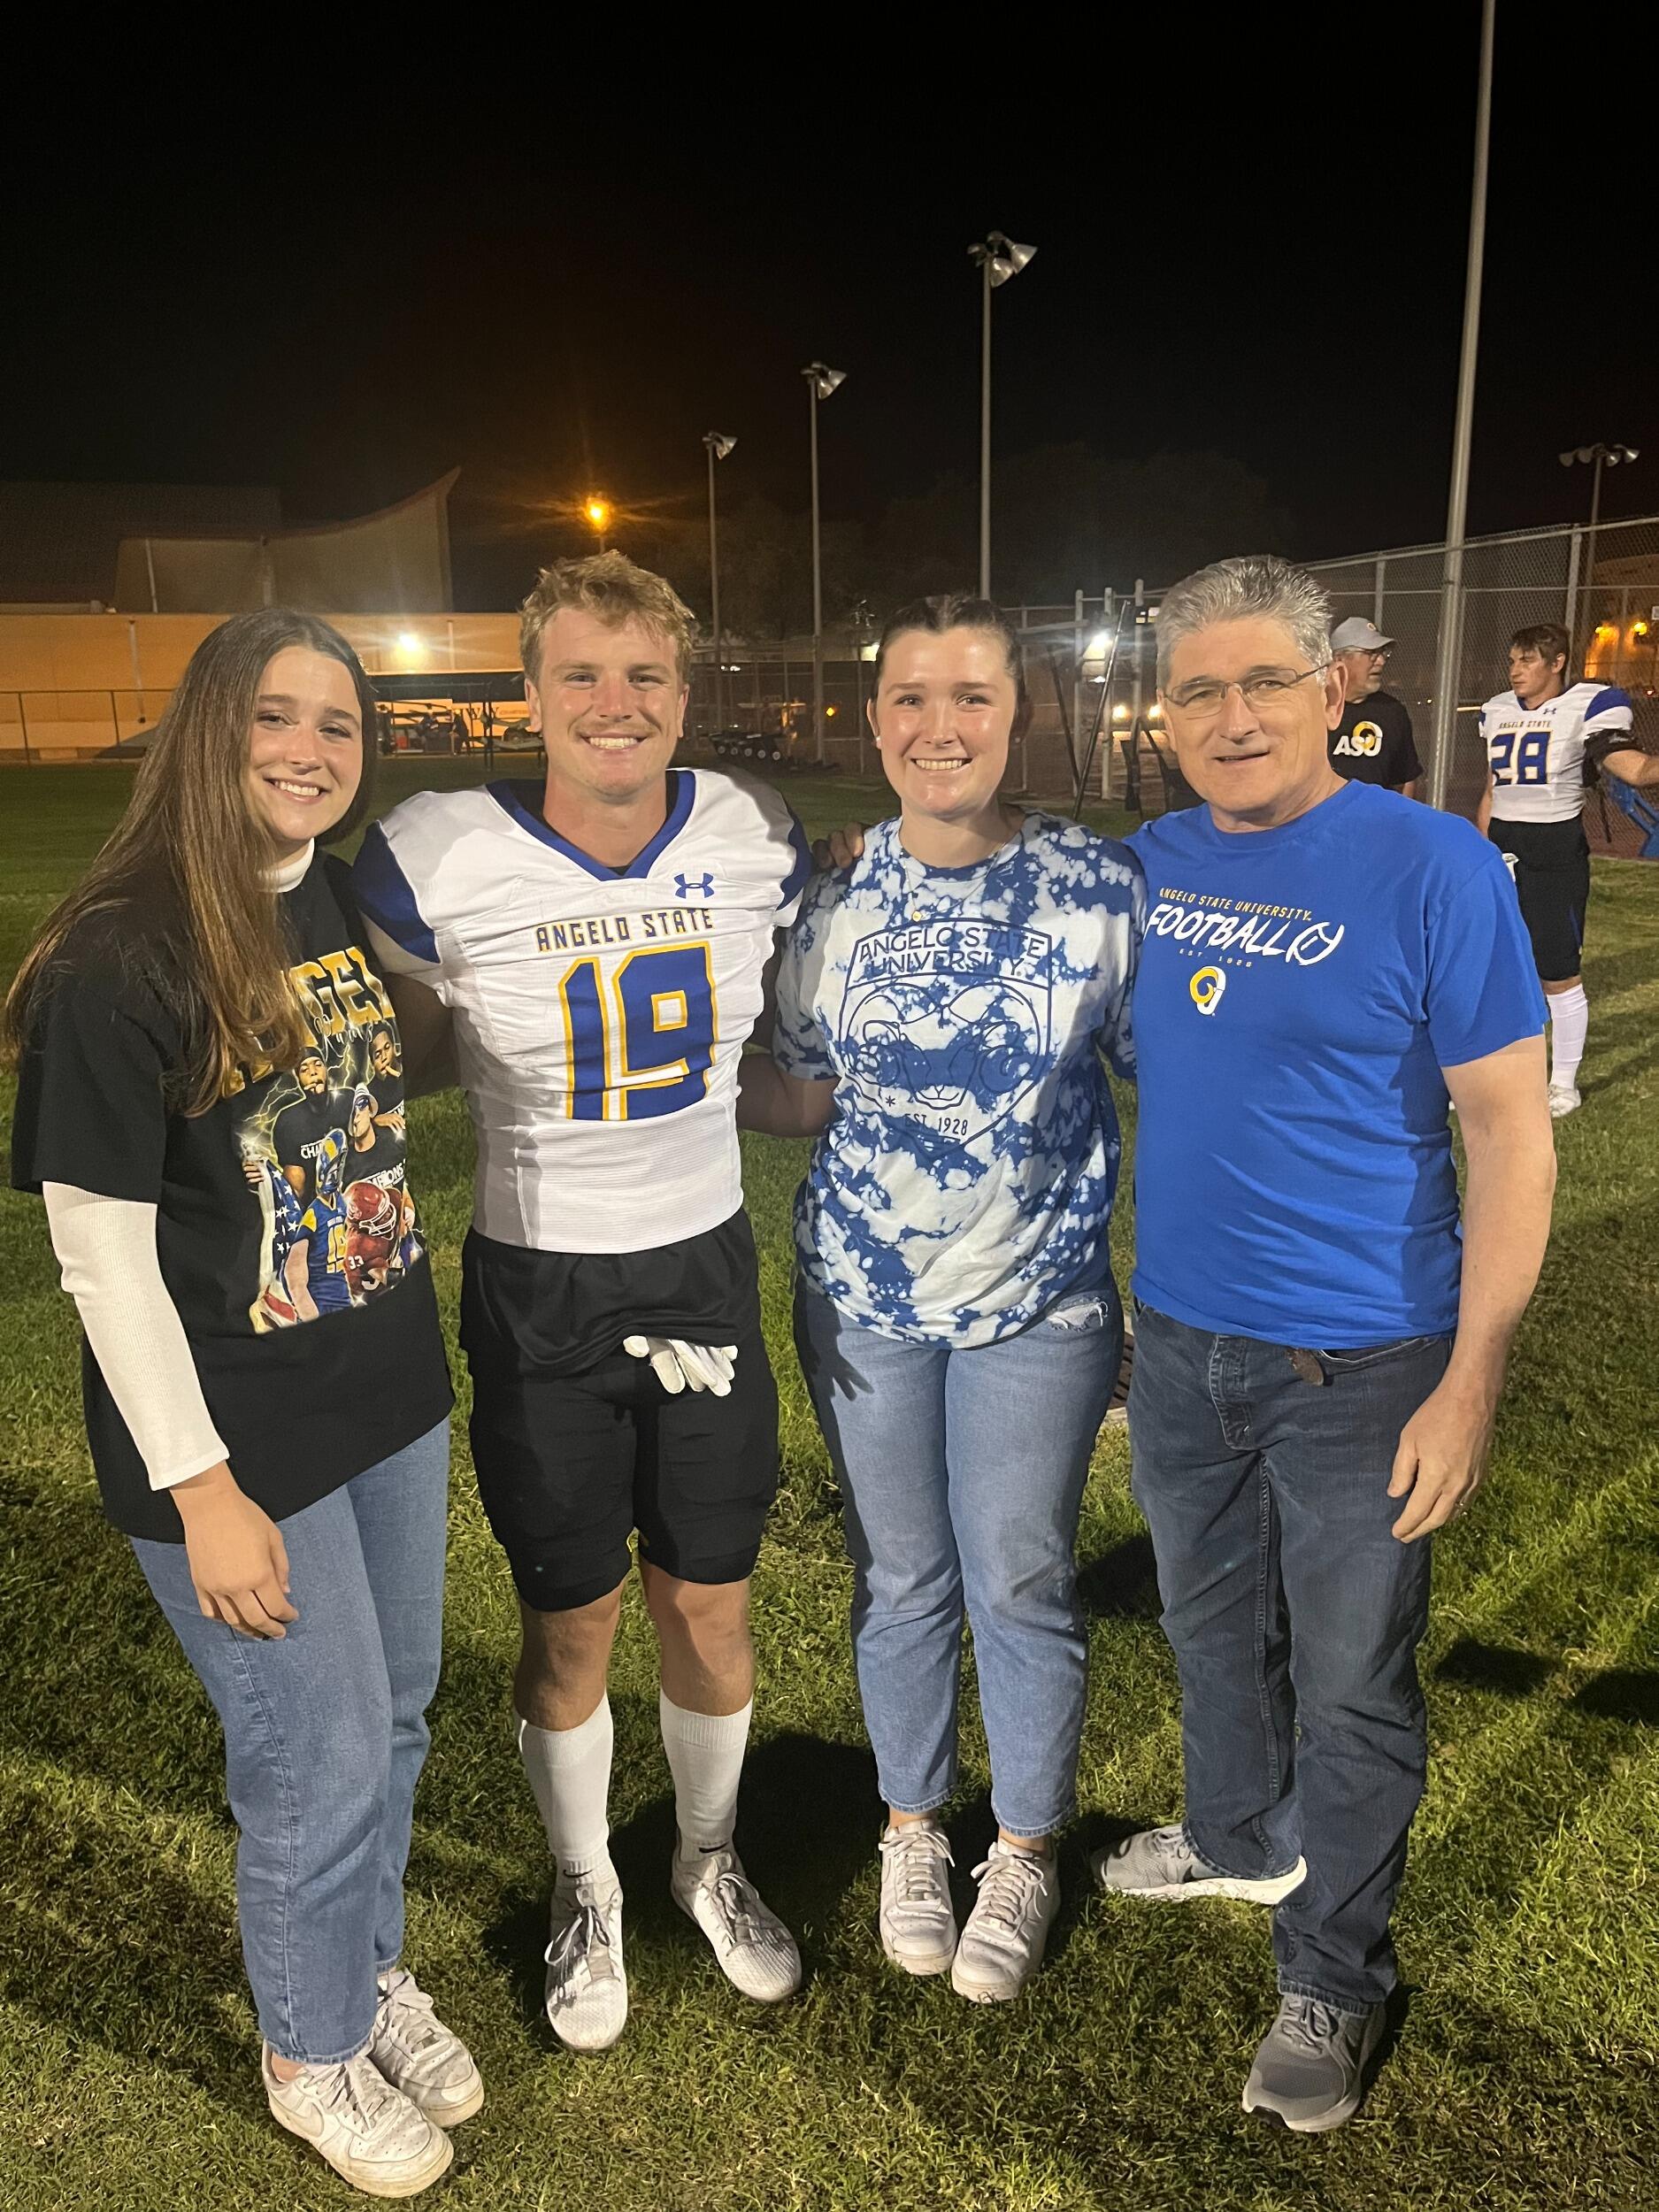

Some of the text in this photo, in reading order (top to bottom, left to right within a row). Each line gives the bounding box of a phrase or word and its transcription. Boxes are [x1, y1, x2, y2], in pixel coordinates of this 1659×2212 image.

[1490, 730, 1552, 786] 28
[1160, 887, 1196, 904] ANGELO
[1198, 895, 1233, 910] STATE
[535, 908, 713, 953] ANGELO STATE
[859, 926, 1046, 964] ANGELO STATE
[1143, 903, 1290, 956] FOOTBALL
[868, 949, 1025, 976] UNIVERSITY
[557, 941, 718, 1121] 19
[938, 1117, 968, 1136] 1928
